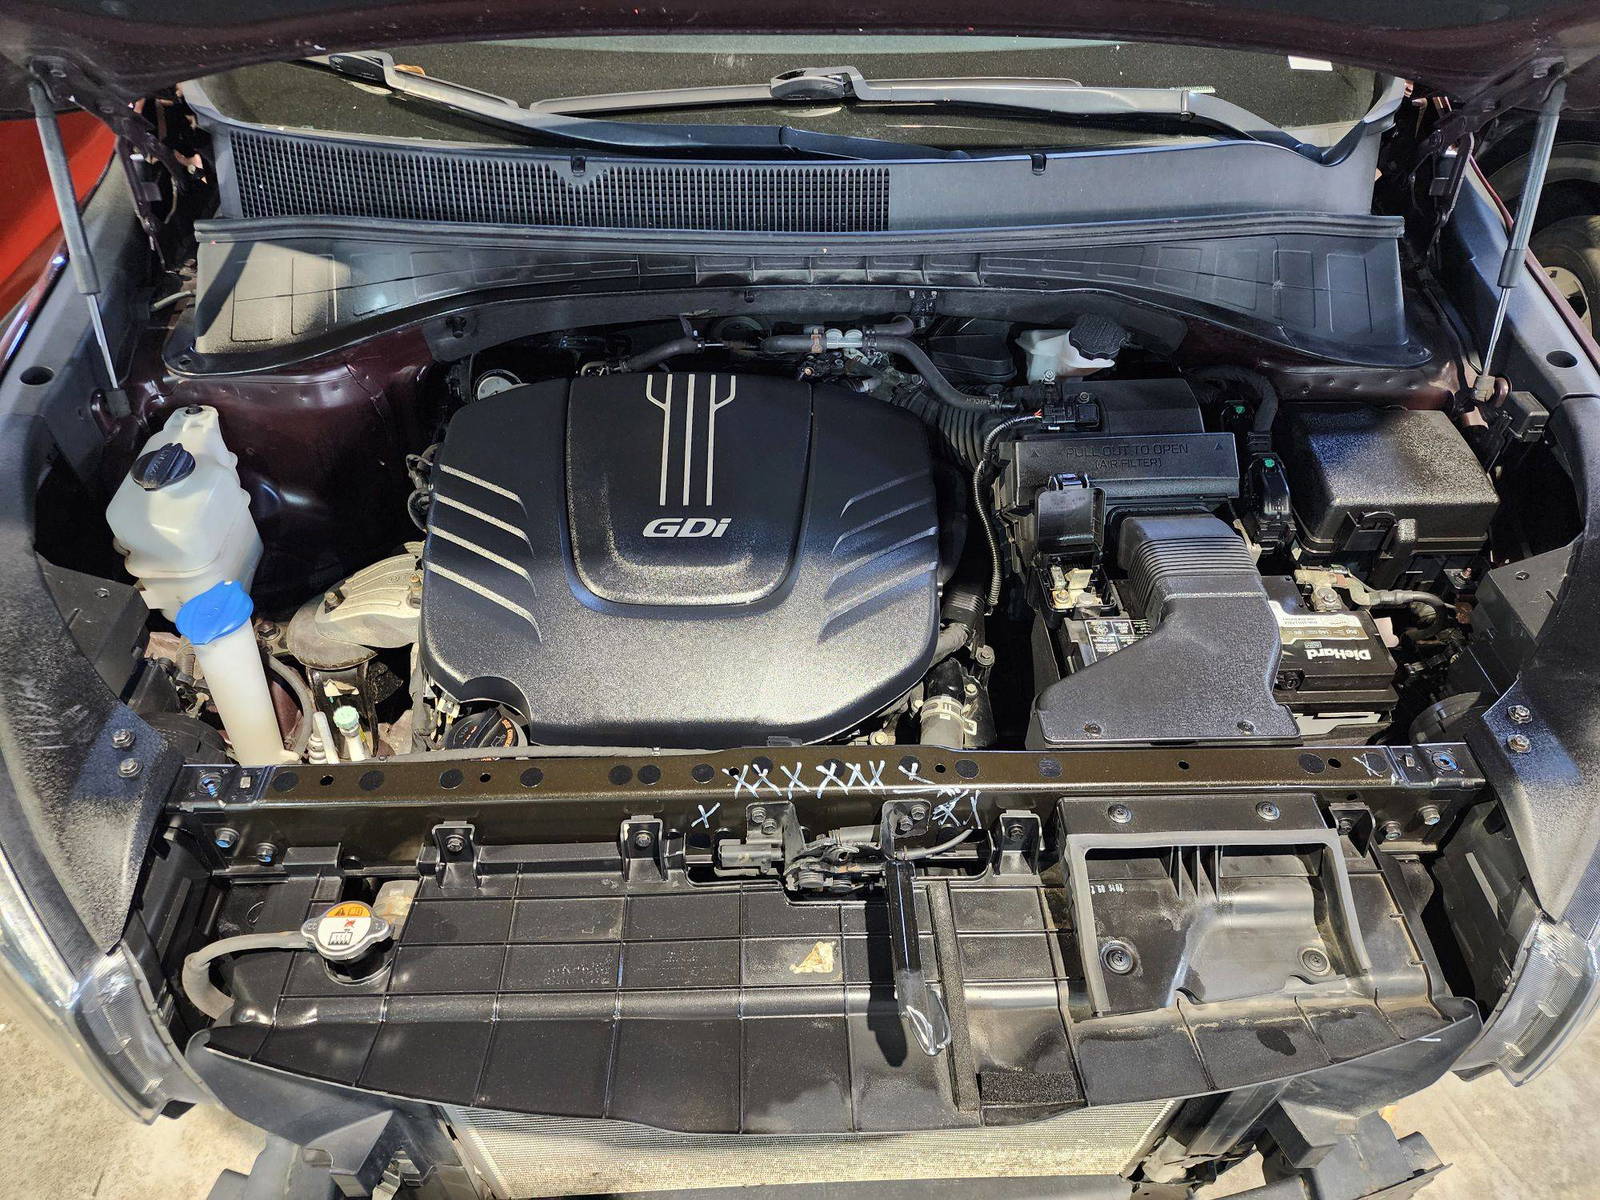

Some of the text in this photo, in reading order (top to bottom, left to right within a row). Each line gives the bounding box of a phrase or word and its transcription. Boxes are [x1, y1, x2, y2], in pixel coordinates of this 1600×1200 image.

[1066, 443, 1189, 458] PULL OUT TO OPEN
[642, 517, 732, 538] GDi
[1305, 648, 1372, 661] DieHard
